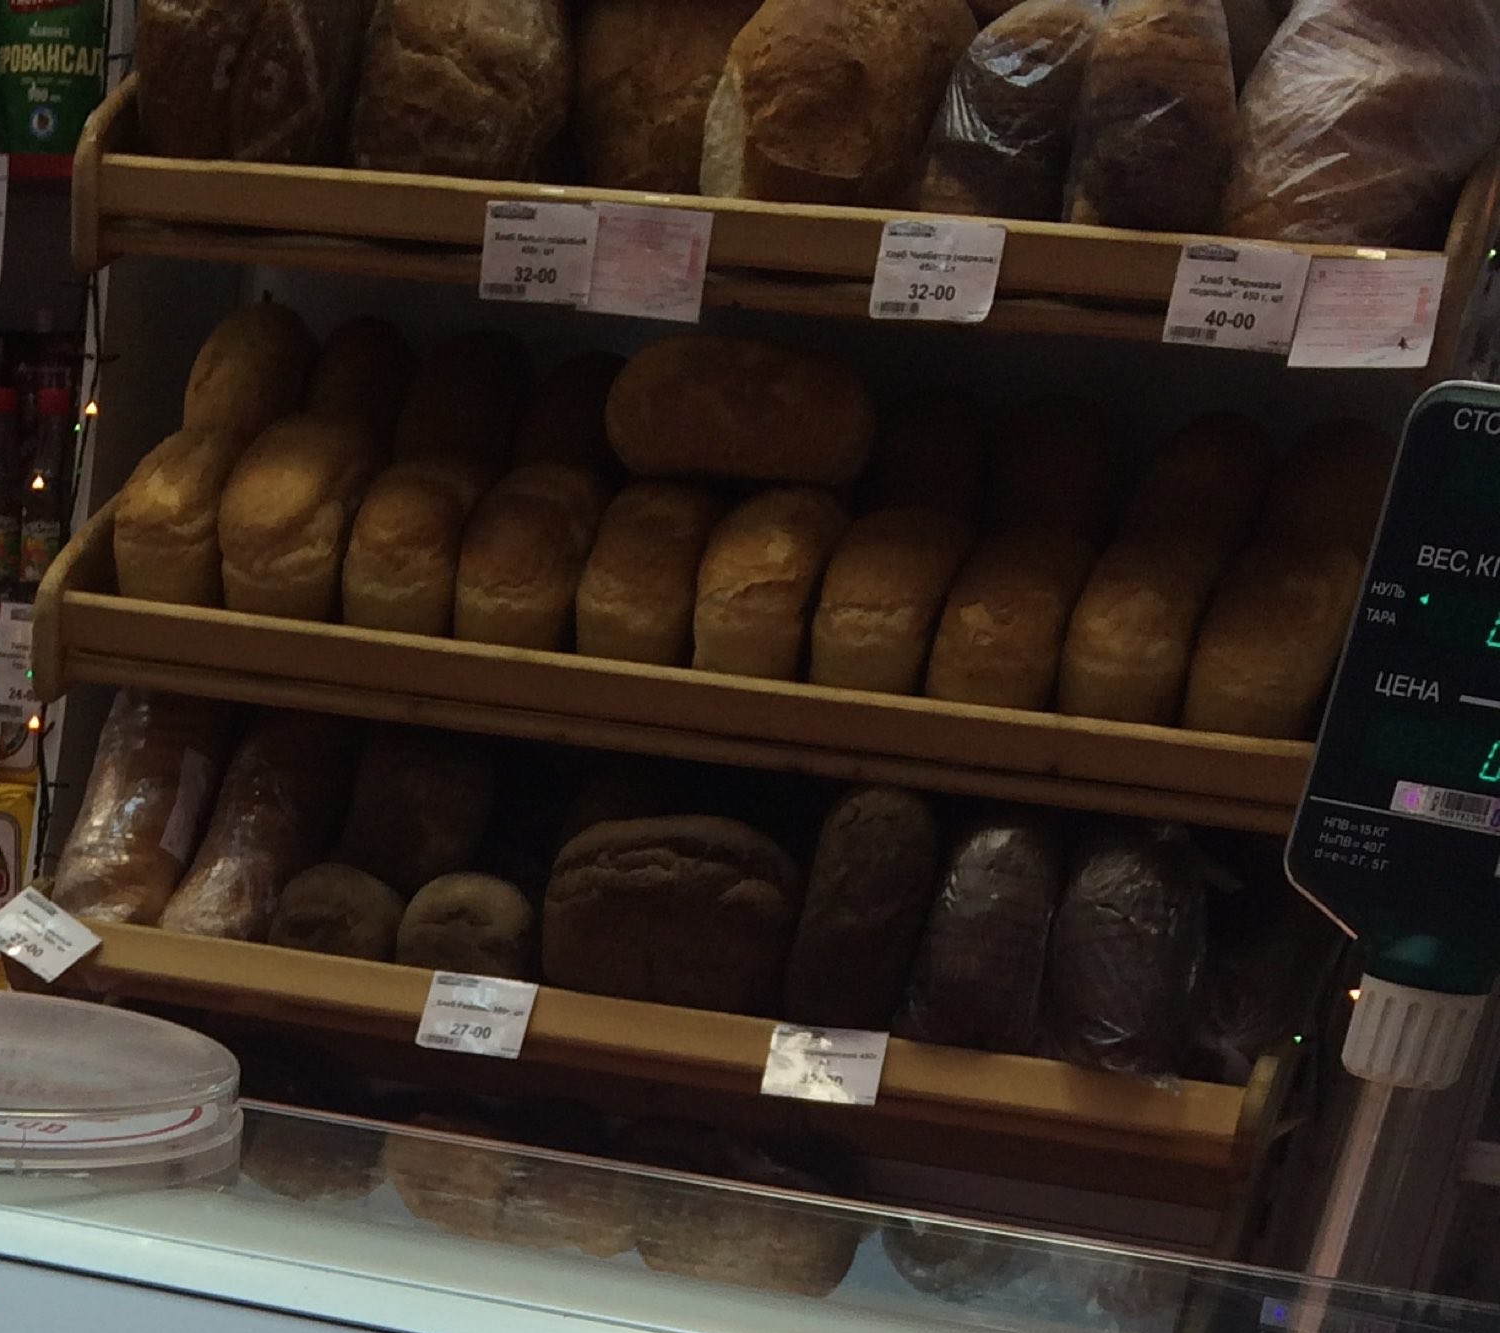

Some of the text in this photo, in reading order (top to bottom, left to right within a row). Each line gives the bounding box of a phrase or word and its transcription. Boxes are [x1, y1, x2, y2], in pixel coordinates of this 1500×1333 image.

[514, 266, 557, 284] 32-00
[908, 283, 956, 301] 32-00
[1205, 309, 1256, 330] 40-00
[1417, 544, 1471, 578] ВЕС,
[1371, 581, 1406, 598] НУЛЬ
[1366, 607, 1397, 626] ТАРА
[1374, 670, 1441, 703] ЦЕНА
[450, 1022, 492, 1040] 27-00
